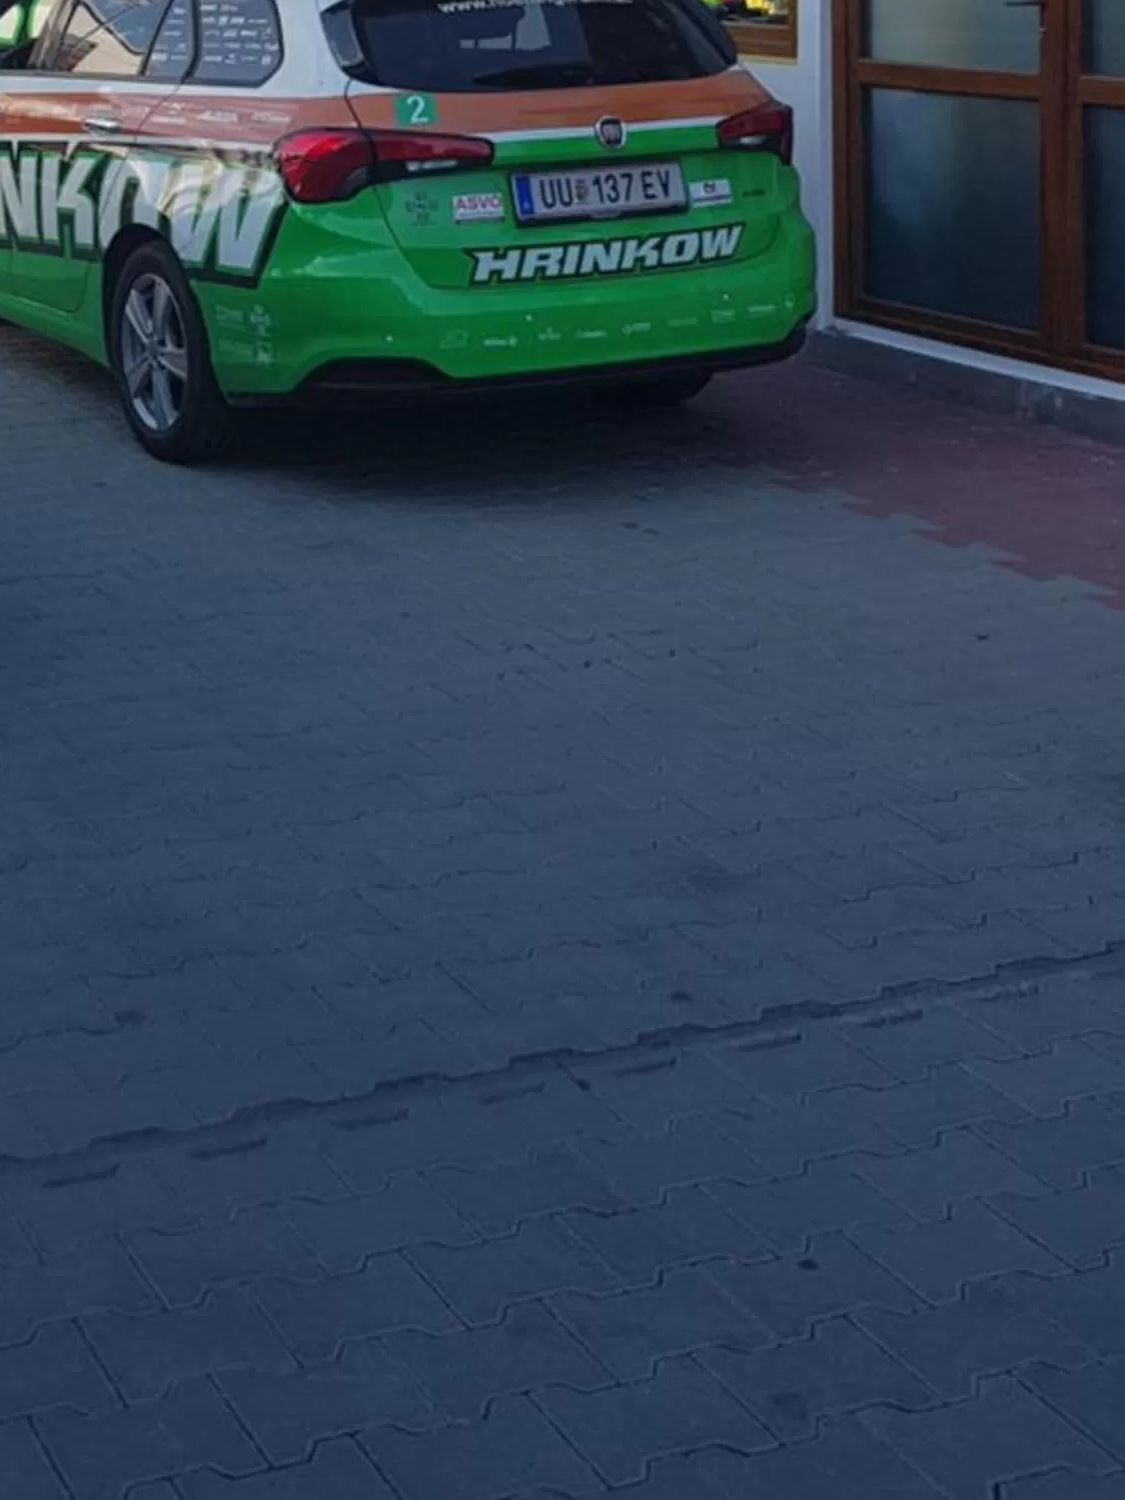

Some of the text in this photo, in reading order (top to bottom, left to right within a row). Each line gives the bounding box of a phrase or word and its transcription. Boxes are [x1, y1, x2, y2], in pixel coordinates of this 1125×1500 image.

[405, 96, 429, 125] 2
[539, 177, 574, 209] UU
[475, 225, 744, 282] HRINKOW
